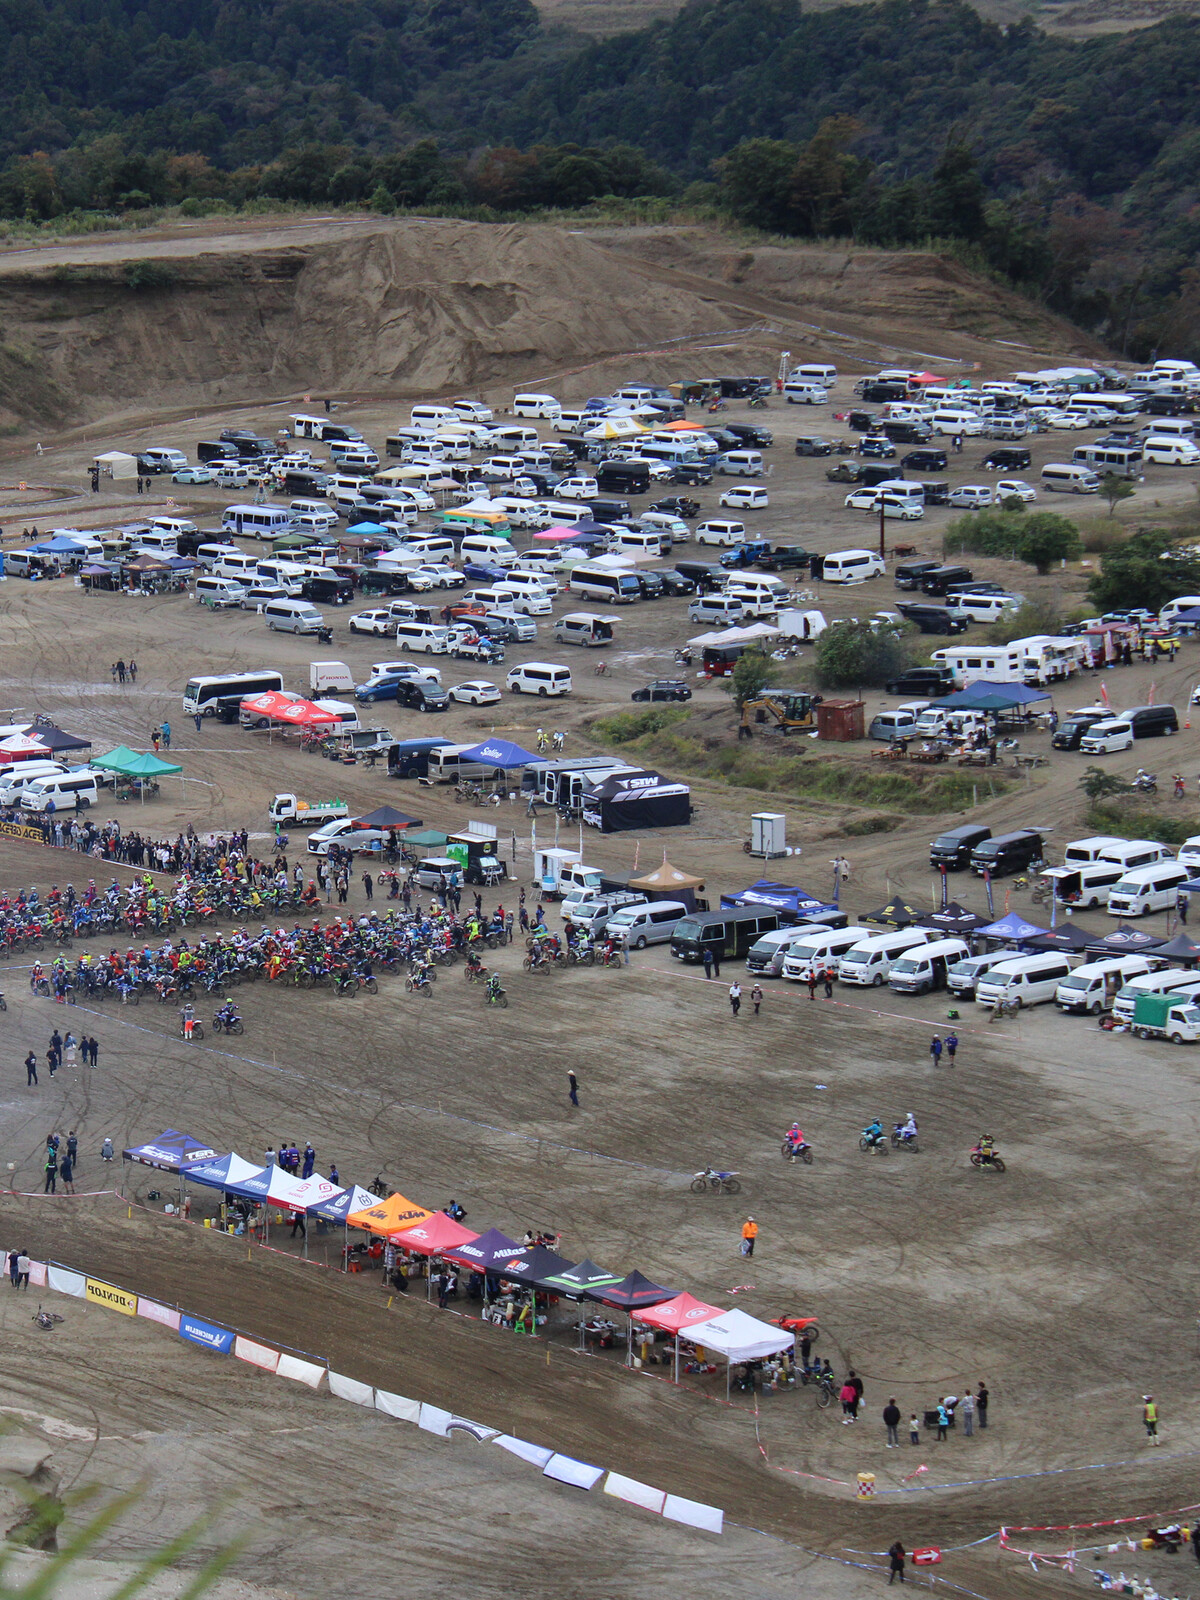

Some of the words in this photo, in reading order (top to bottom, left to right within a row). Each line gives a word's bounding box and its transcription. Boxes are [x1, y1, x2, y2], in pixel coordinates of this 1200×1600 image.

[480, 746, 503, 759] Spline
[366, 1209, 388, 1220] KTM
[398, 1210, 426, 1221] KTM
[456, 1244, 485, 1258] Mitas
[493, 1247, 527, 1259] Mitas
